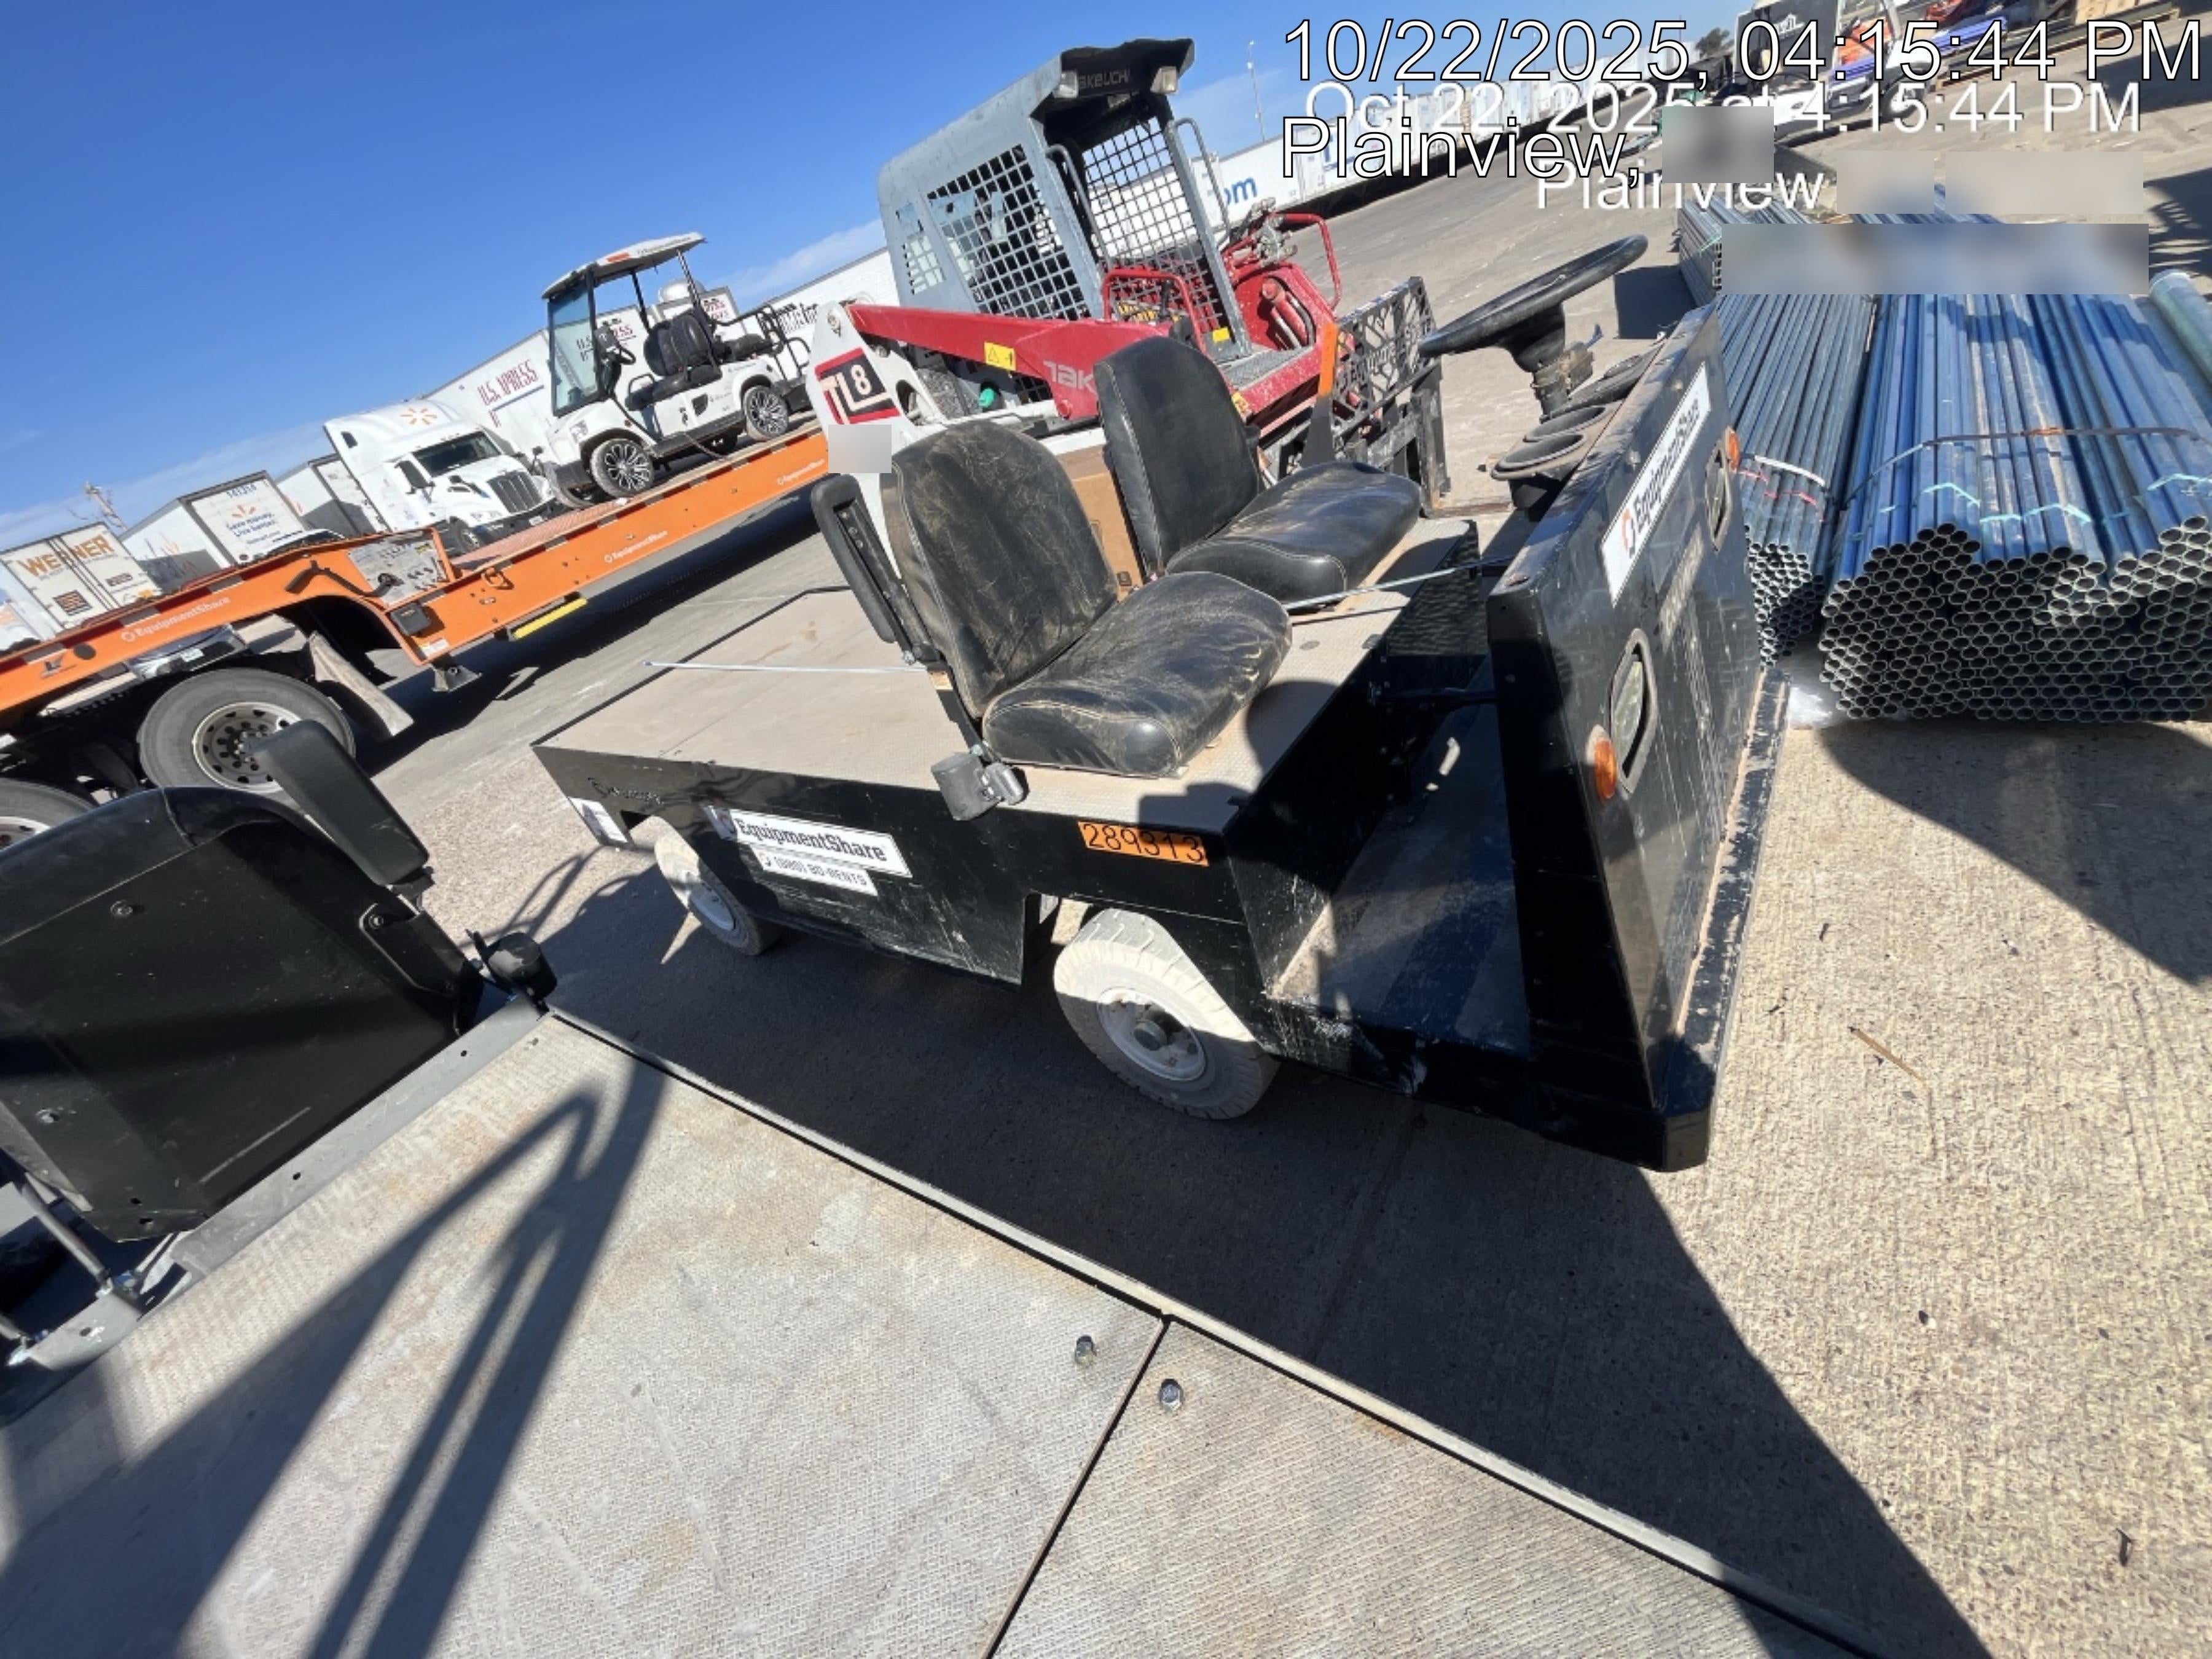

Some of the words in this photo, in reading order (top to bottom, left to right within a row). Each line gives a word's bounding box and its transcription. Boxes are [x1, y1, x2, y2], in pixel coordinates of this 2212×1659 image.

[818, 364, 887, 425] TL8
[1633, 398, 1700, 534] EquipmentShare
[17, 534, 114, 576] WENER
[734, 817, 888, 861] EquipmentShare
[1083, 823, 1205, 863] 289313
